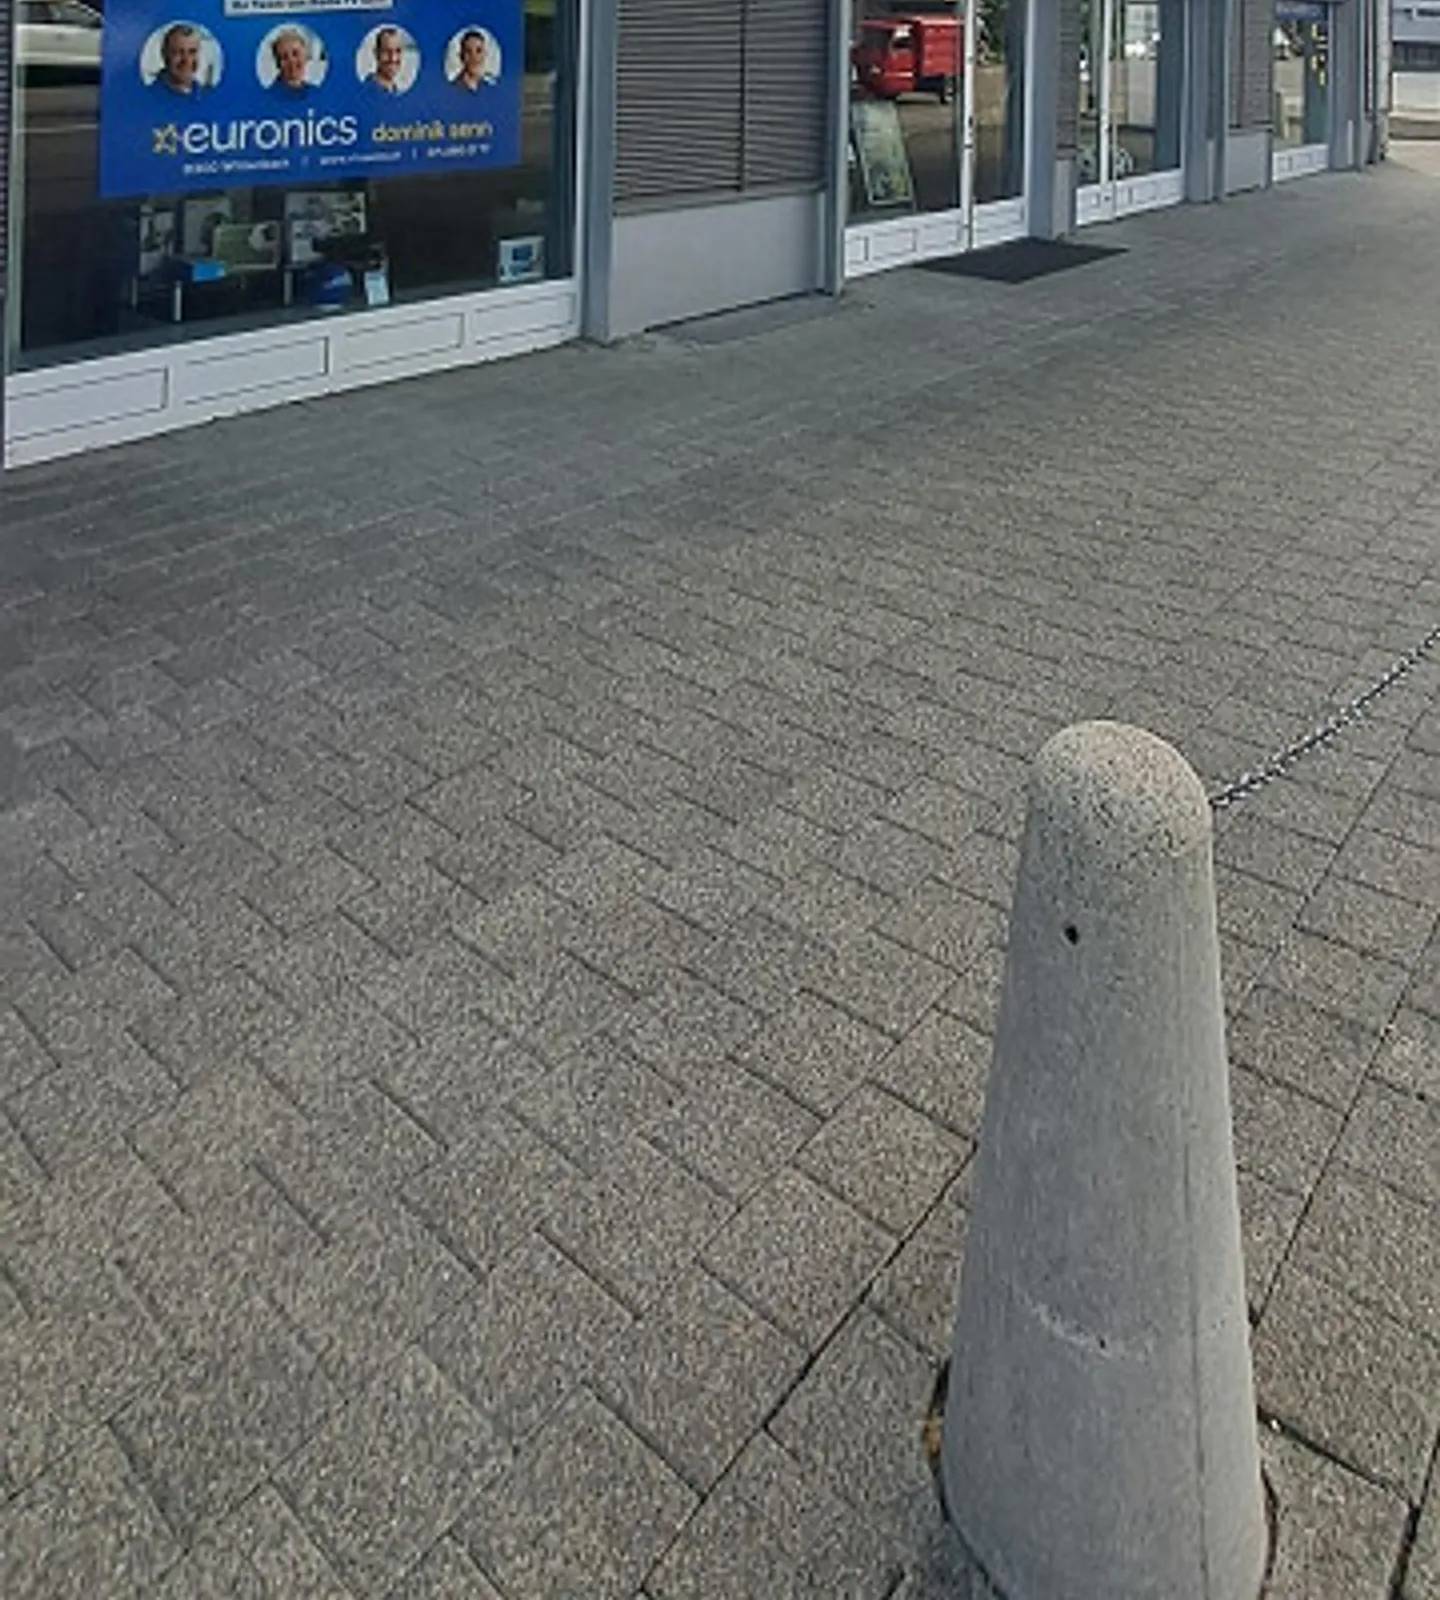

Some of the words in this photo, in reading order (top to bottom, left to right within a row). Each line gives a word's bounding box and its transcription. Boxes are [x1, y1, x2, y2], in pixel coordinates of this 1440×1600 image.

[183, 107, 358, 154] euronics
[372, 119, 445, 142] dominik
[448, 120, 494, 139] senn
